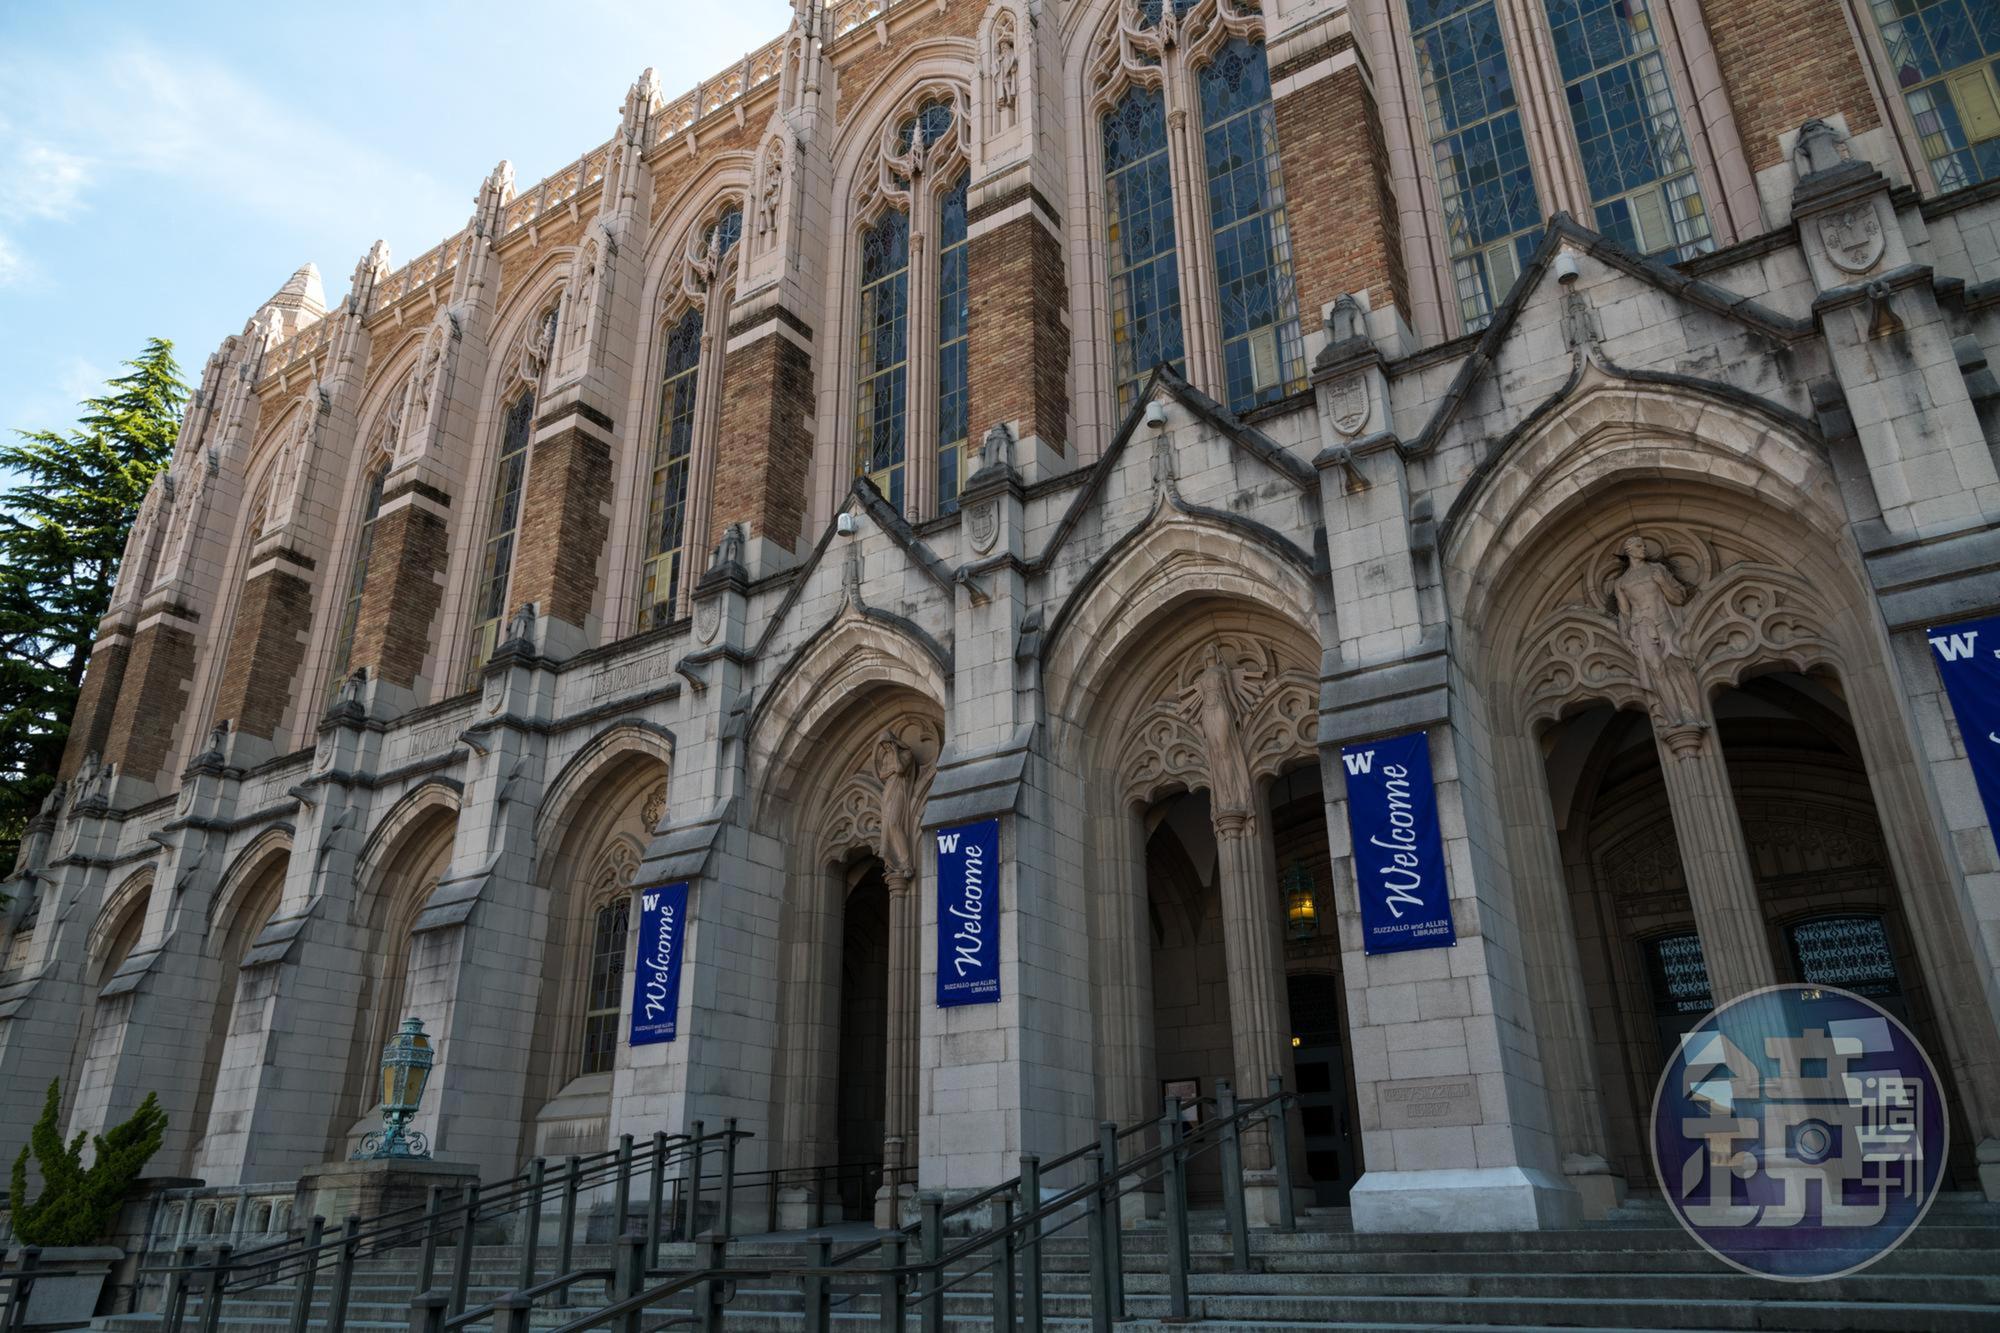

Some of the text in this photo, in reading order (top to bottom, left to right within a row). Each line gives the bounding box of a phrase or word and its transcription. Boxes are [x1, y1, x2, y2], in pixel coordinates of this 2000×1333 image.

[1928, 631, 1978, 662] W
[1342, 750, 1375, 776] W
[937, 833, 960, 854] W
[1370, 764, 1424, 918] Welcome
[642, 893, 660, 912] W
[949, 844, 983, 977] Welcome
[1373, 920, 1448, 934] SUZZALLO and ALLEN
[1413, 927, 1449, 937] LIBRARIES
[644, 905, 674, 1020] Welcome
